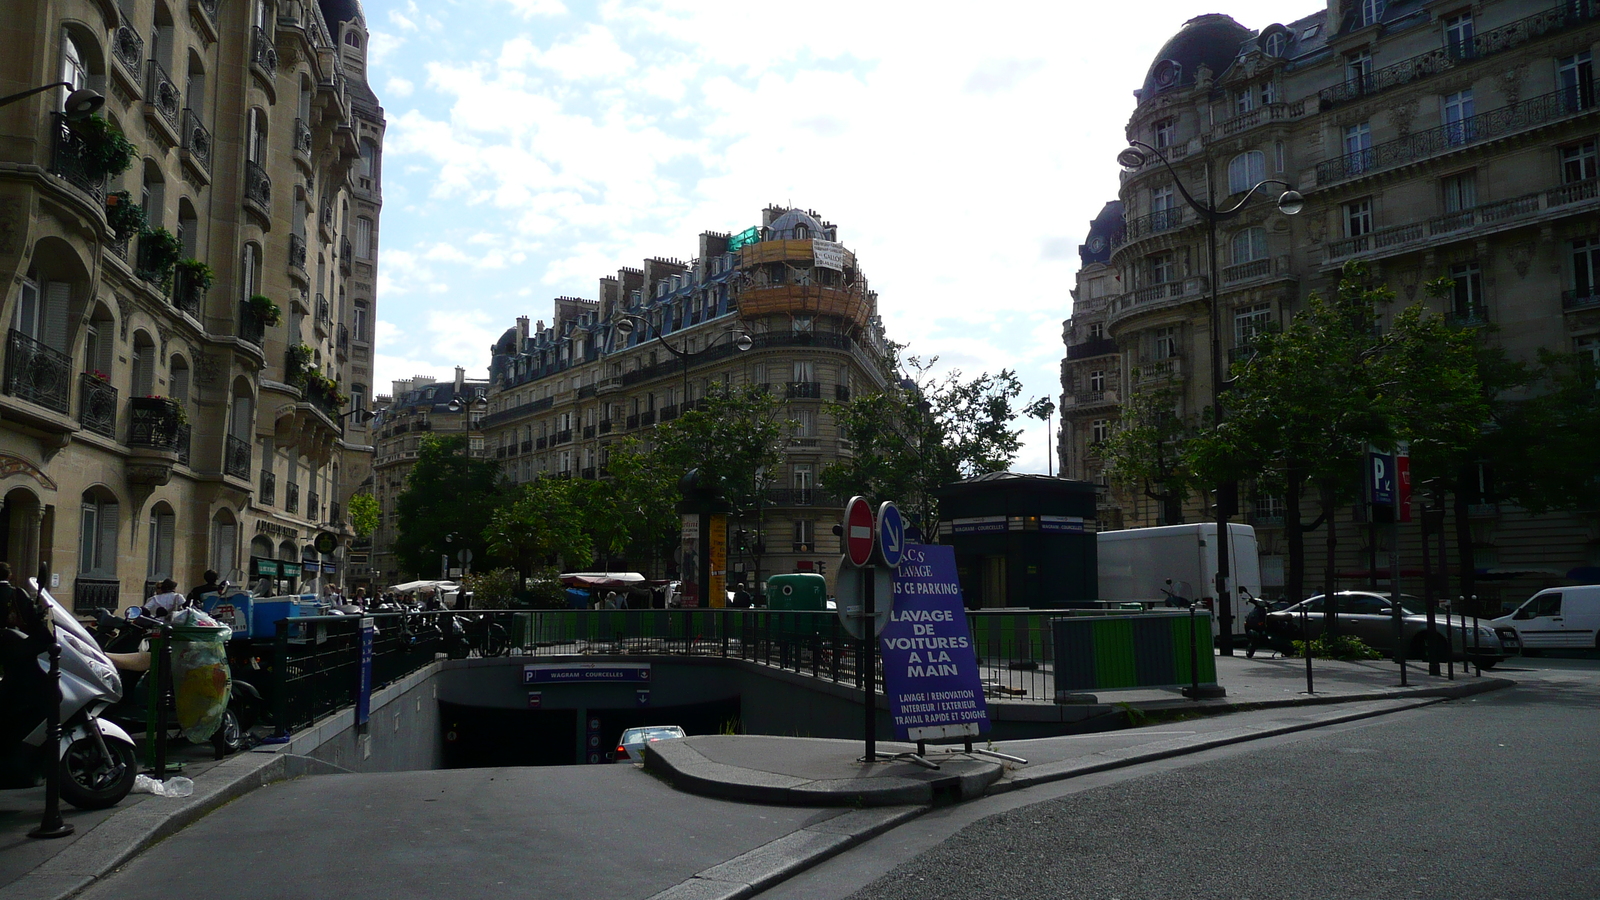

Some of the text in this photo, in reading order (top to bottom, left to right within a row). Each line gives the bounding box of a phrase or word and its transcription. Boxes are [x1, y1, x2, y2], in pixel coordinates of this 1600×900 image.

[1374, 457, 1385, 490] P
[977, 524, 1005, 532] COURCELLES
[898, 565, 933, 578] LAVAGE
[904, 582, 915, 595] CE
[917, 583, 958, 595] PARKING
[890, 610, 954, 622] LAVAGE
[913, 624, 936, 636] DE
[884, 636, 969, 650] VOITURES
[908, 651, 951, 663] A LA
[526, 671, 534, 682] P
[907, 664, 958, 678] MAIN
[899, 692, 926, 703] LAVAGE
[931, 689, 975, 701] RENOVATION
[901, 703, 936, 714] INTERIEUR
[941, 700, 977, 711] EXTERIEUR
[895, 710, 987, 726] TRAVAIL RAPIDE ET SOIGNE
